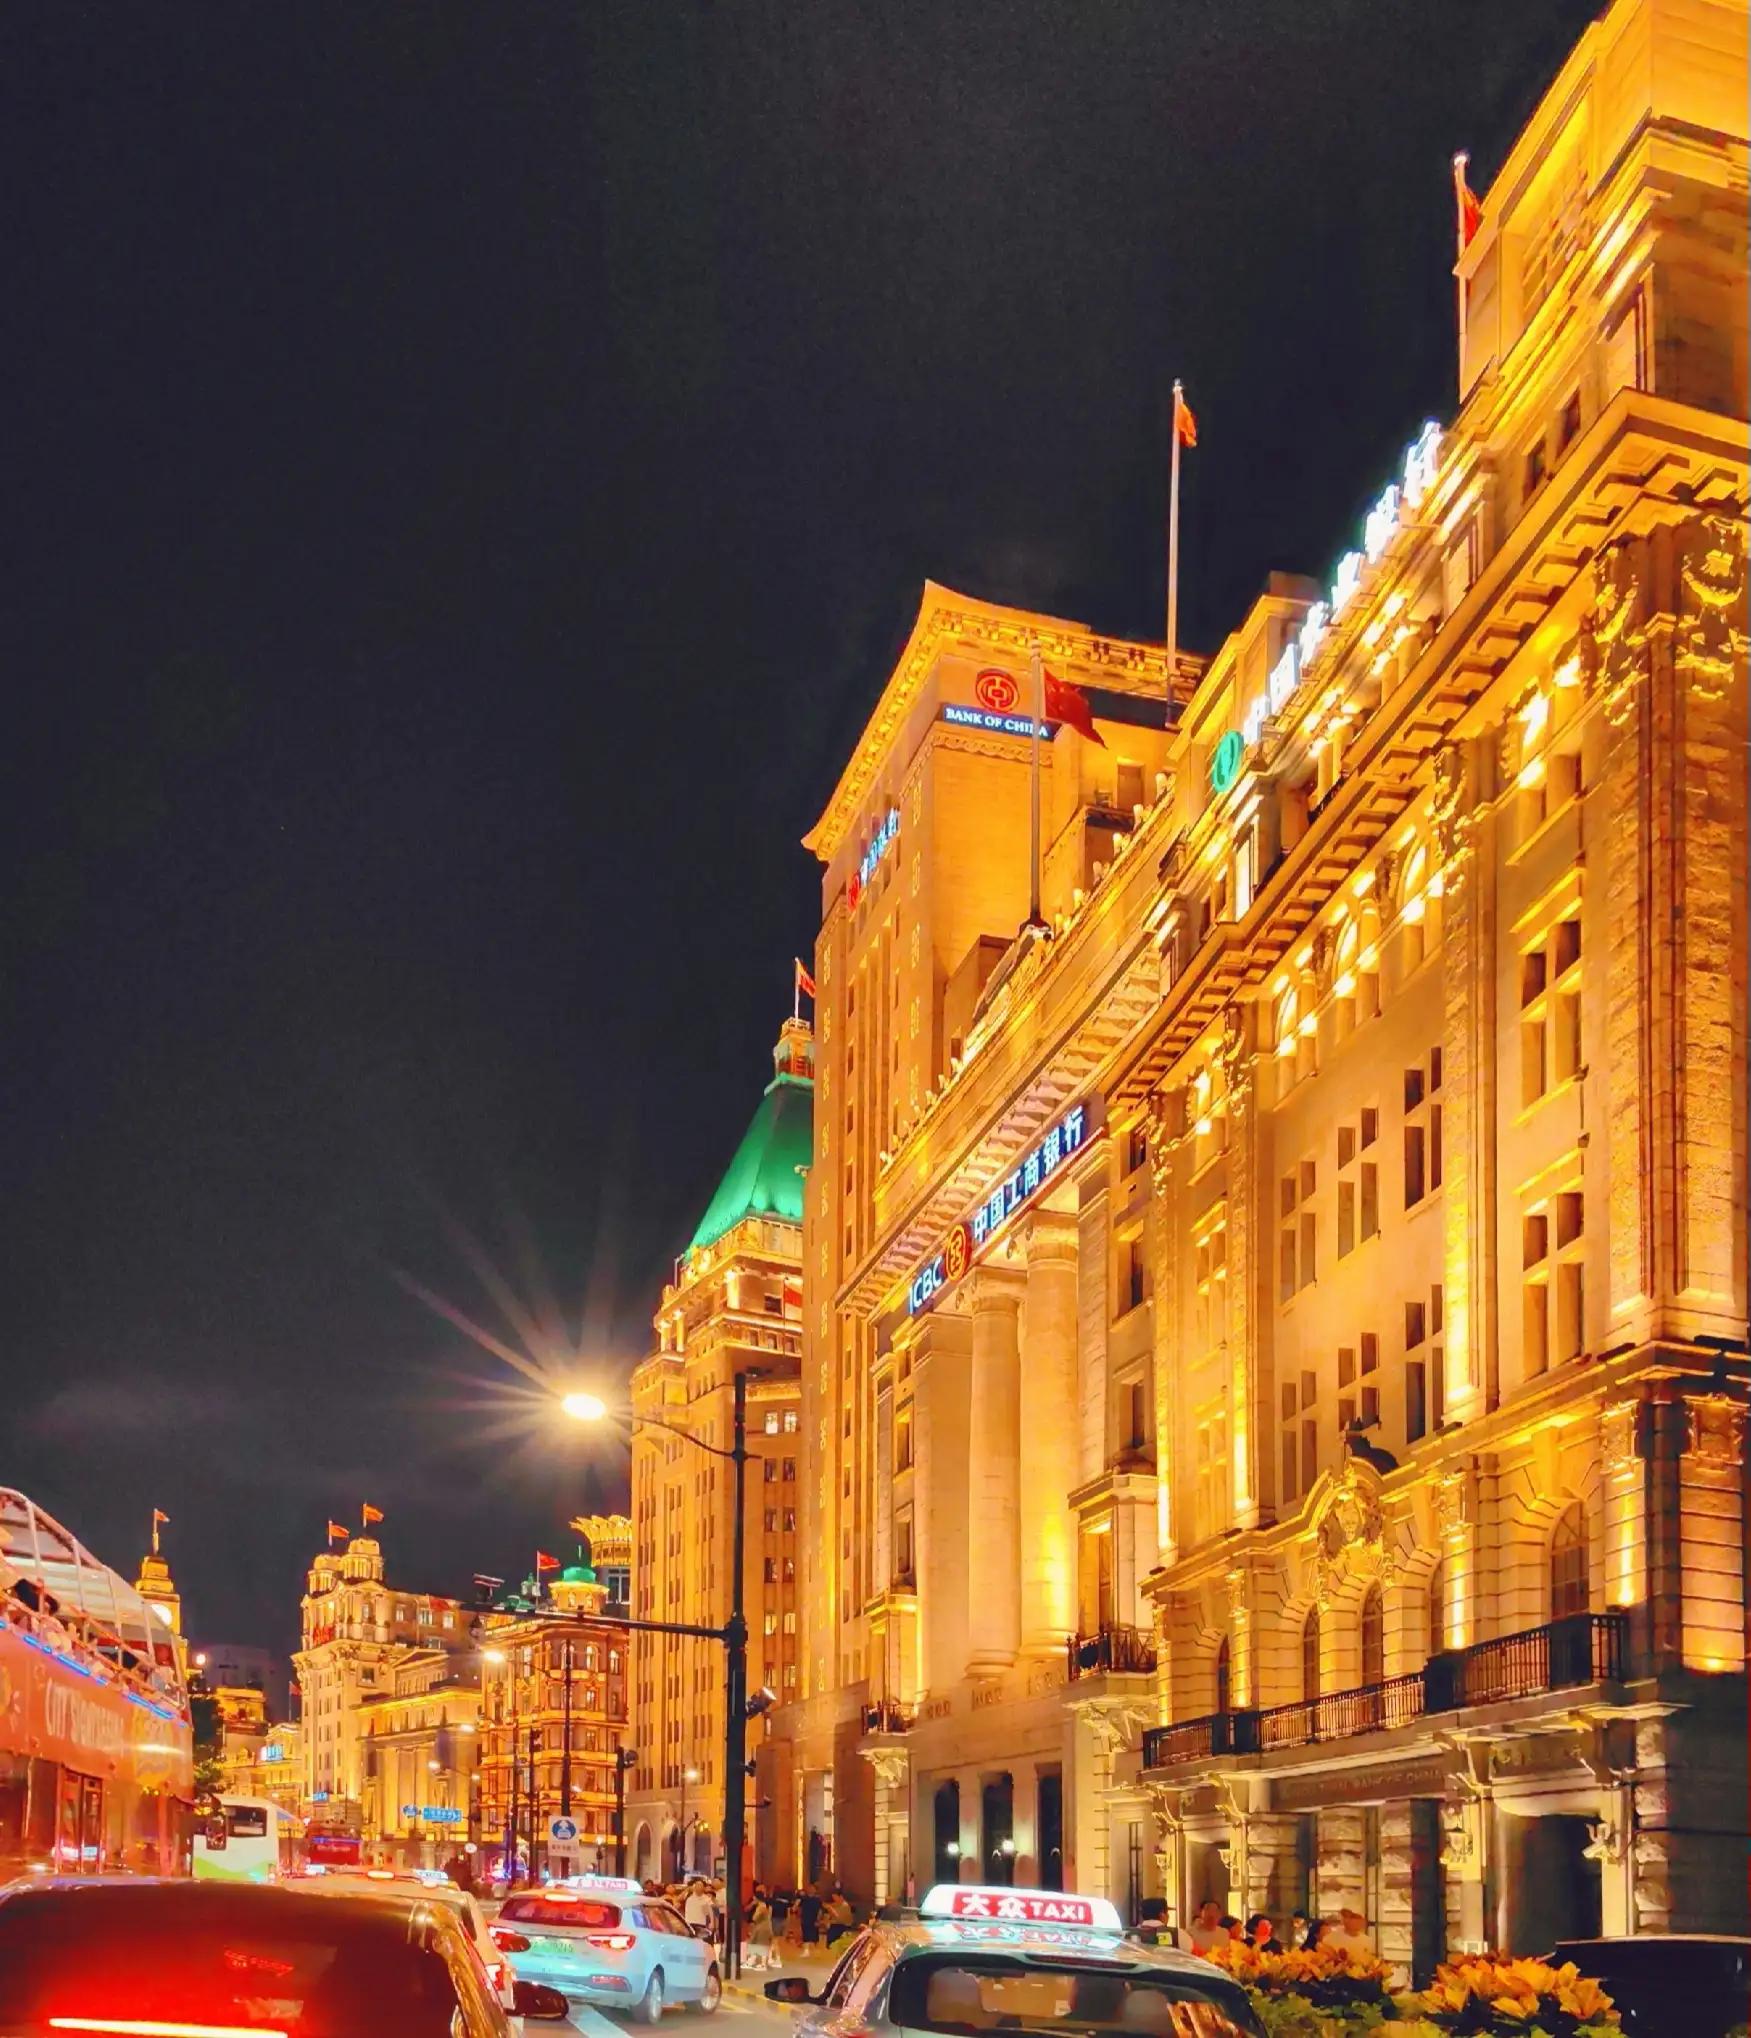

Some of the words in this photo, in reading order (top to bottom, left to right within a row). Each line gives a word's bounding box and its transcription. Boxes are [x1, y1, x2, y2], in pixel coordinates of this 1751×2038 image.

[945, 707, 982, 725] BANK
[985, 715, 1003, 728] OF
[908, 1255, 944, 1314] ICBC
[974, 1105, 1084, 1242] 中国工商银行
[961, 1894, 1027, 1919] 大众
[1029, 1901, 1085, 1920] TAXI
